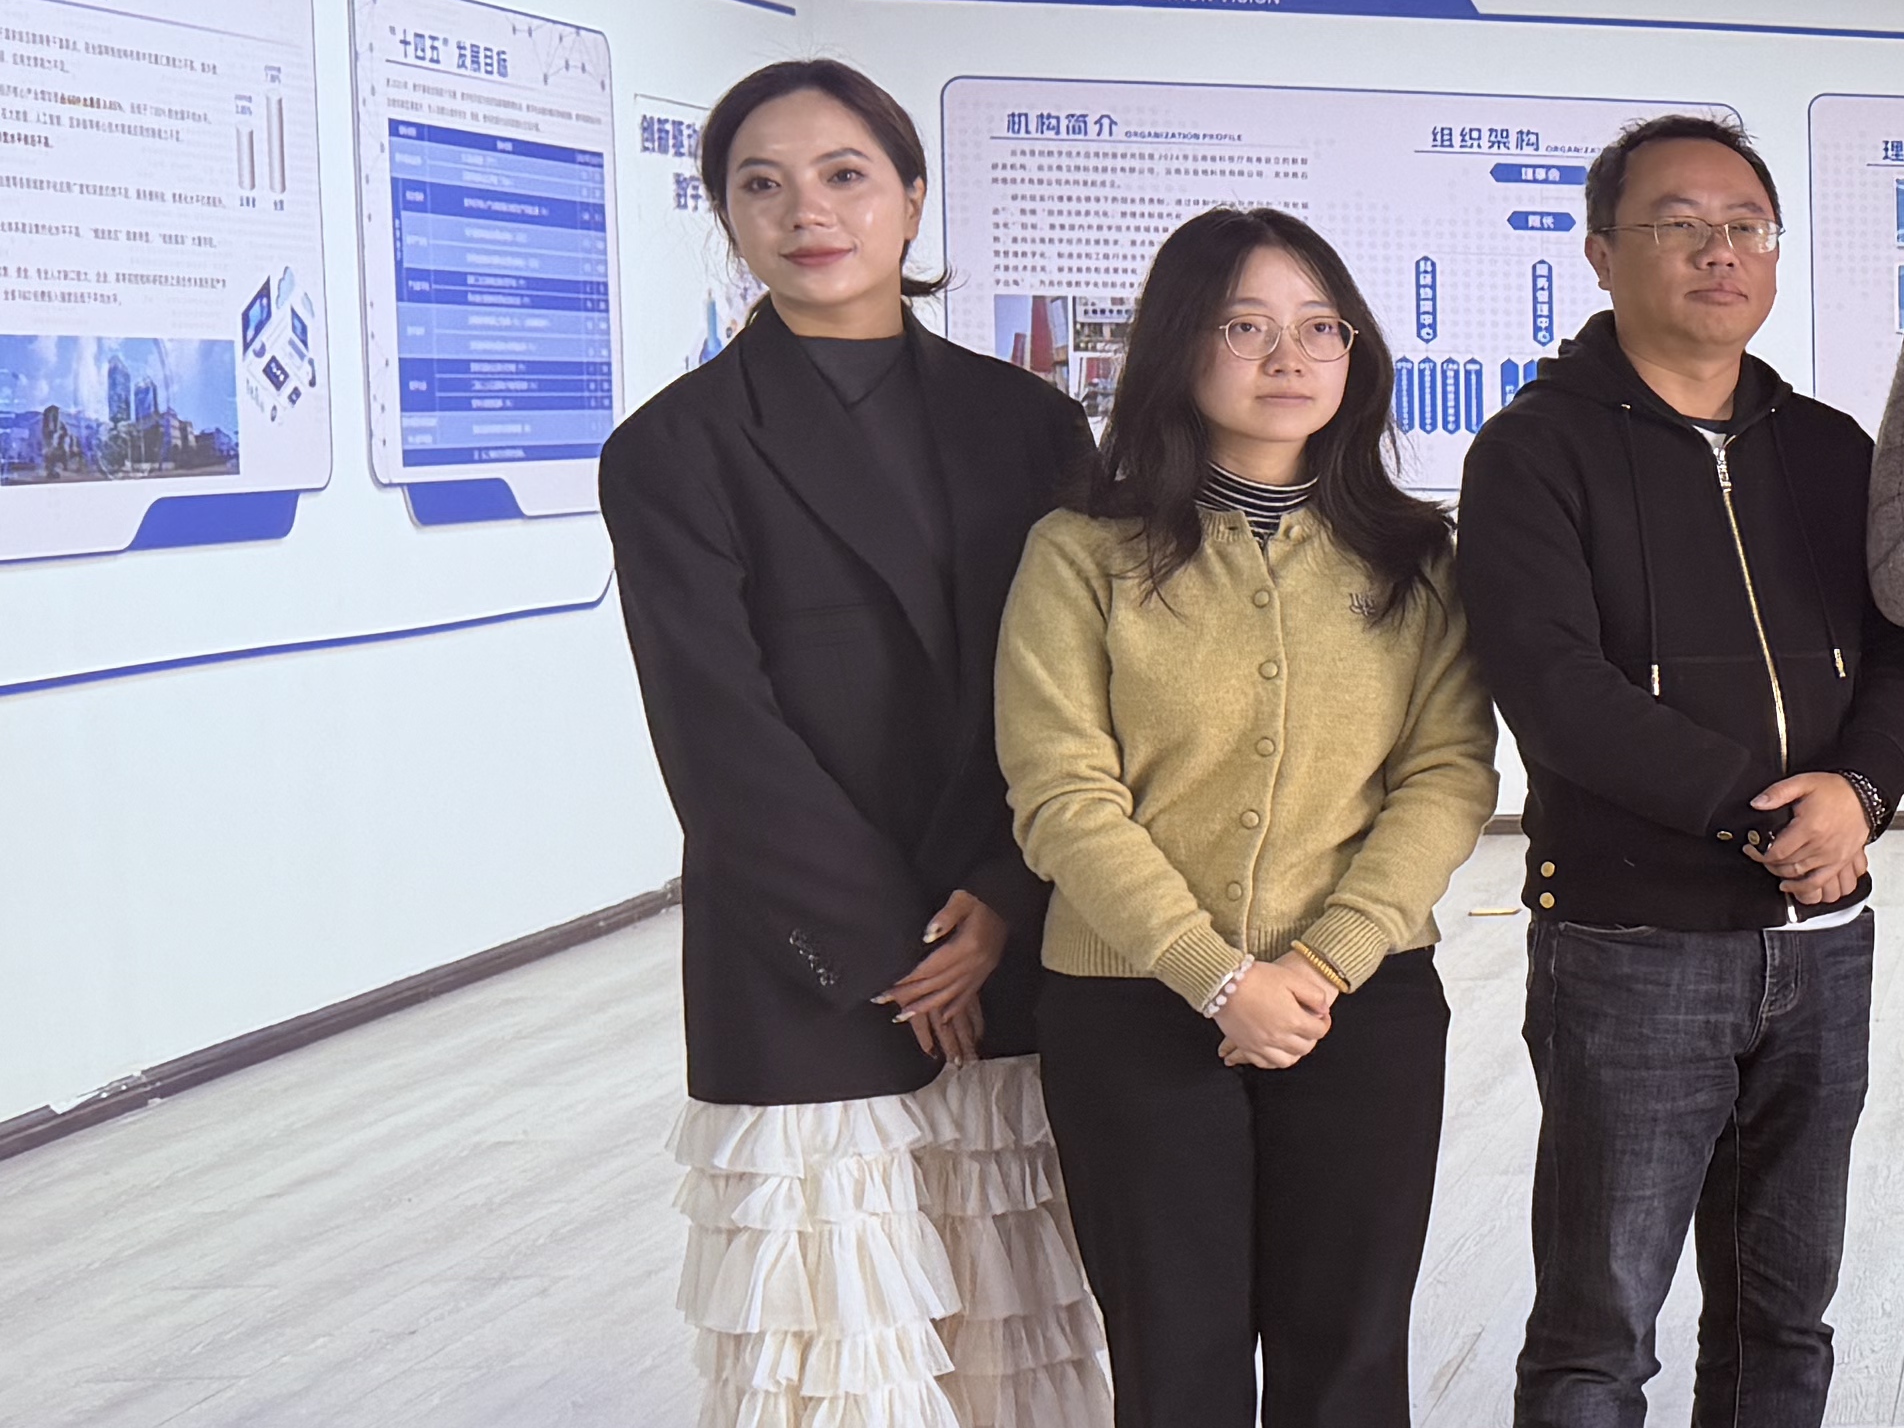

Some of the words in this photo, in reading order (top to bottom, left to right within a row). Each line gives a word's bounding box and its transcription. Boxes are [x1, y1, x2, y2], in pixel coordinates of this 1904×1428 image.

[1006, 111, 1119, 138] 机构简介
[1431, 125, 1540, 152] 组织架构
